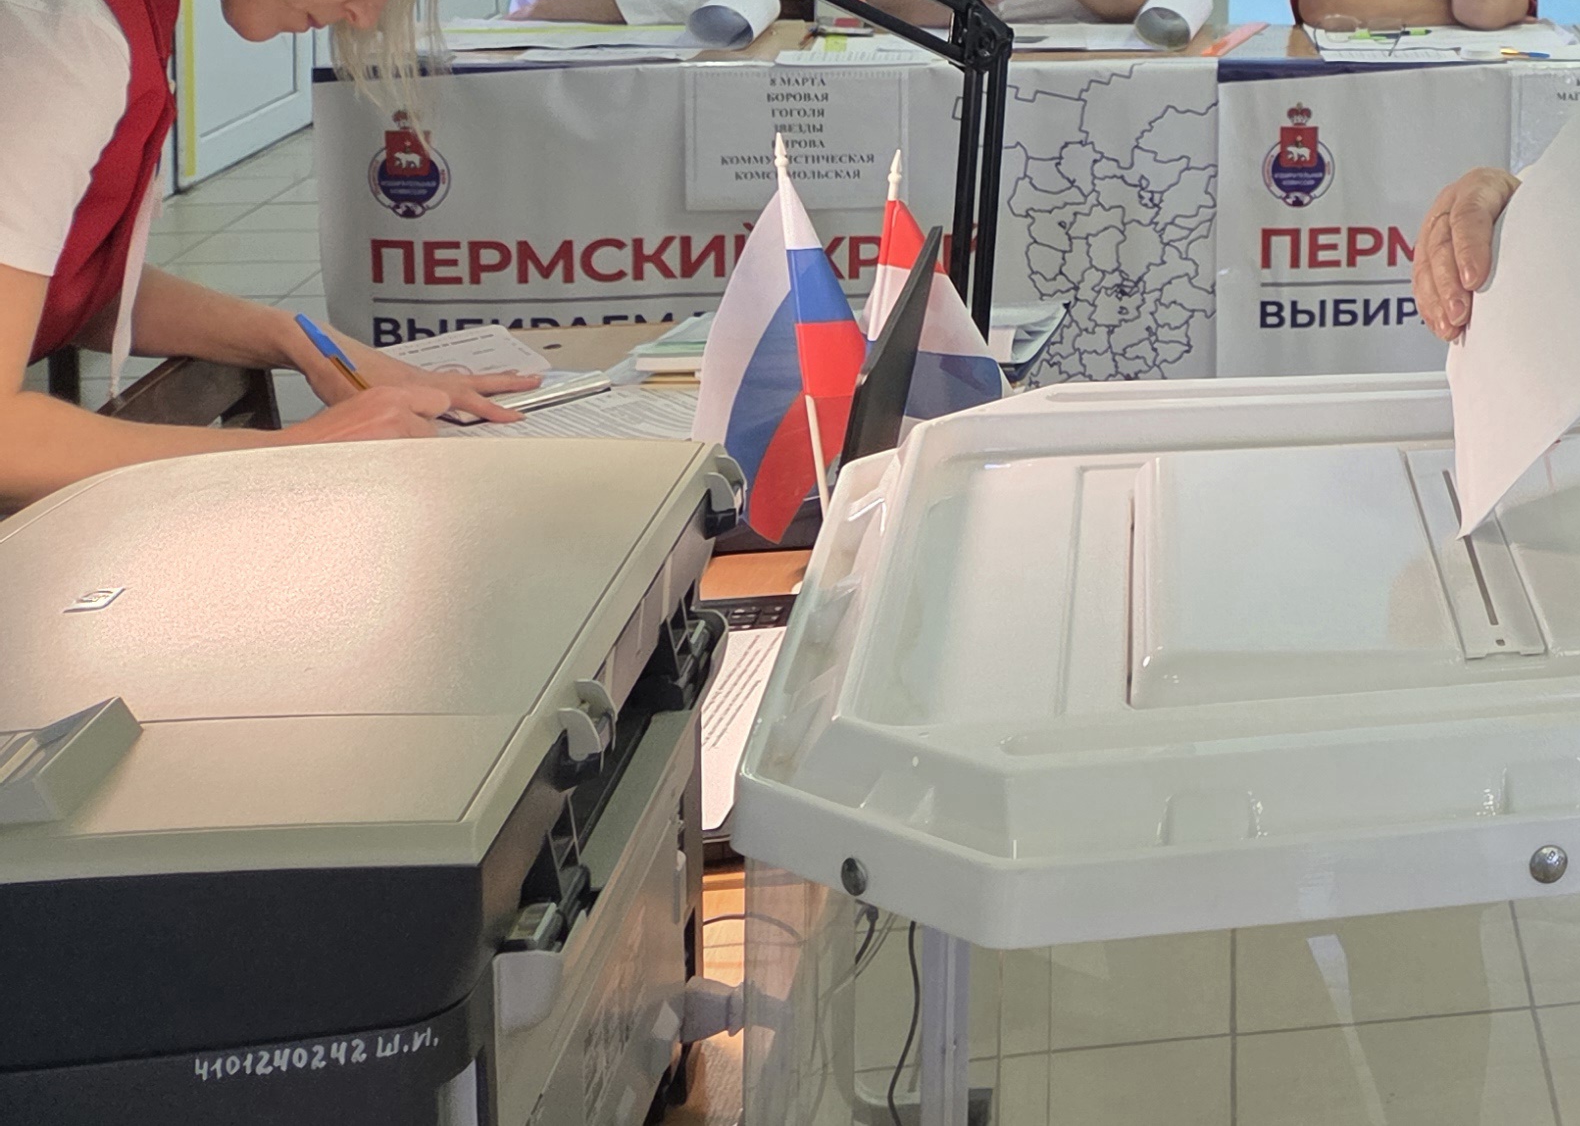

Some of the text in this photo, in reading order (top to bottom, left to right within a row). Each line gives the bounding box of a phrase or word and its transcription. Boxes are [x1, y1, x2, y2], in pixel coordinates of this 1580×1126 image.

[769, 76, 826, 87] 8 МАРТА
[766, 92, 829, 103] БОРОВАЯ
[771, 108, 825, 118] ГОГОЛЯ
[734, 169, 861, 181] КОМСМОЛЬСКАЯ
[195, 1038, 367, 1081] 4101240242
